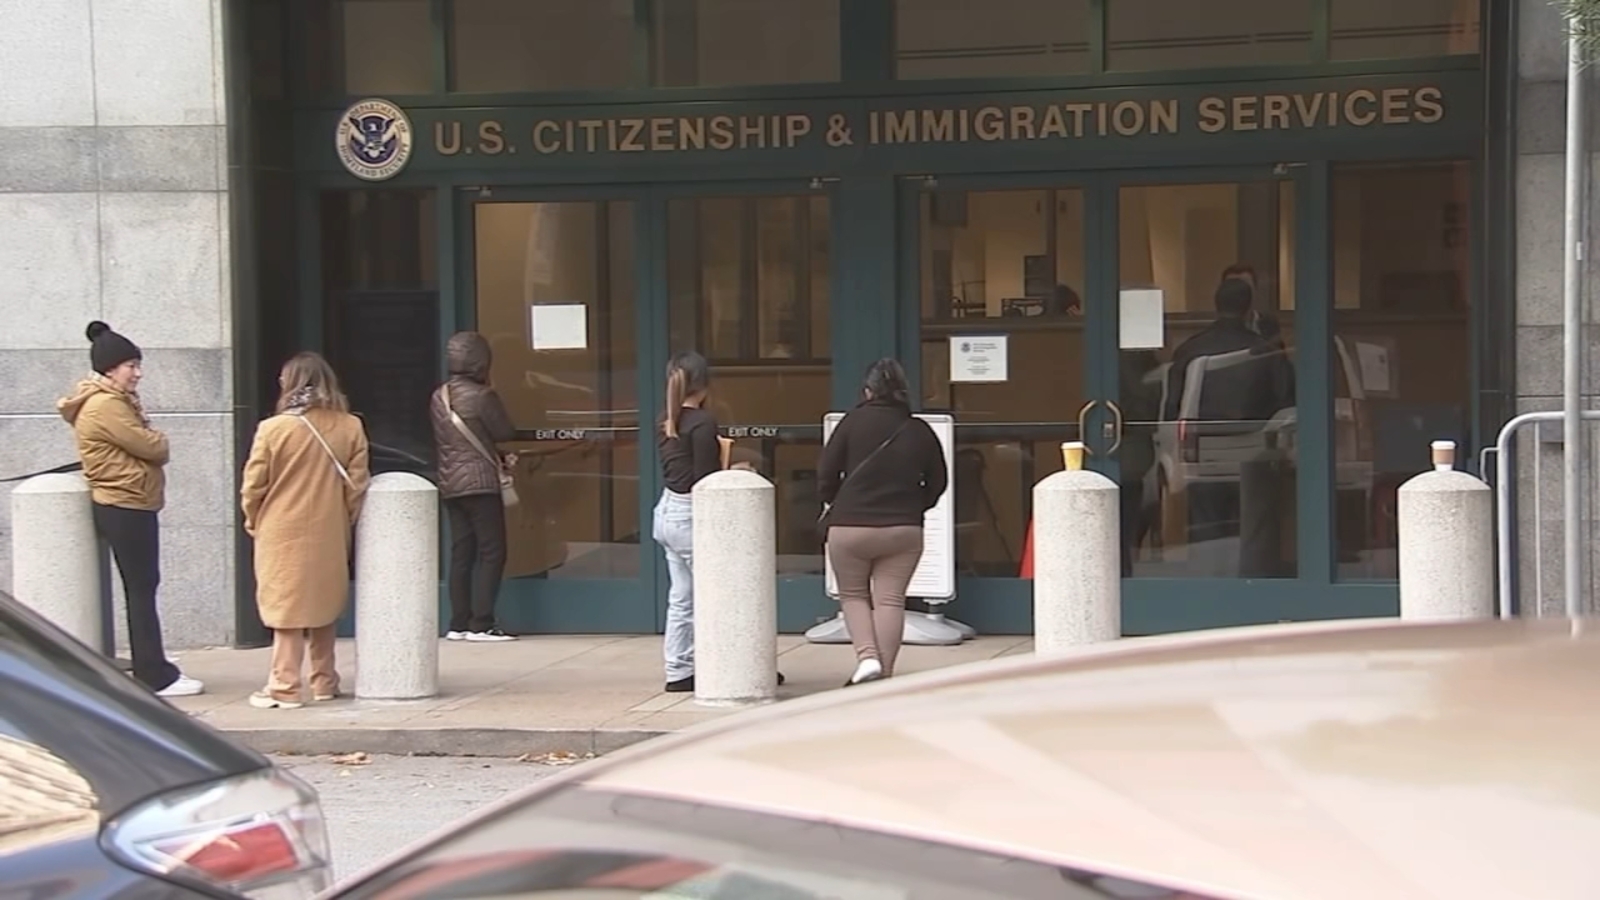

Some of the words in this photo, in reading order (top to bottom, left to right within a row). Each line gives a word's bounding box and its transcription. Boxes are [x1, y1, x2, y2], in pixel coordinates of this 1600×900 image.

[434, 120, 515, 155] U.S.
[532, 115, 811, 154] CITIZENSHIP
[825, 114, 853, 146] &
[869, 100, 1178, 144] IMMIGRATION
[1198, 87, 1444, 133] SERVICES
[536, 429, 555, 440] EXIT
[557, 429, 585, 440] ONLY
[728, 427, 748, 437] EXIT
[750, 427, 778, 437] ONLY
